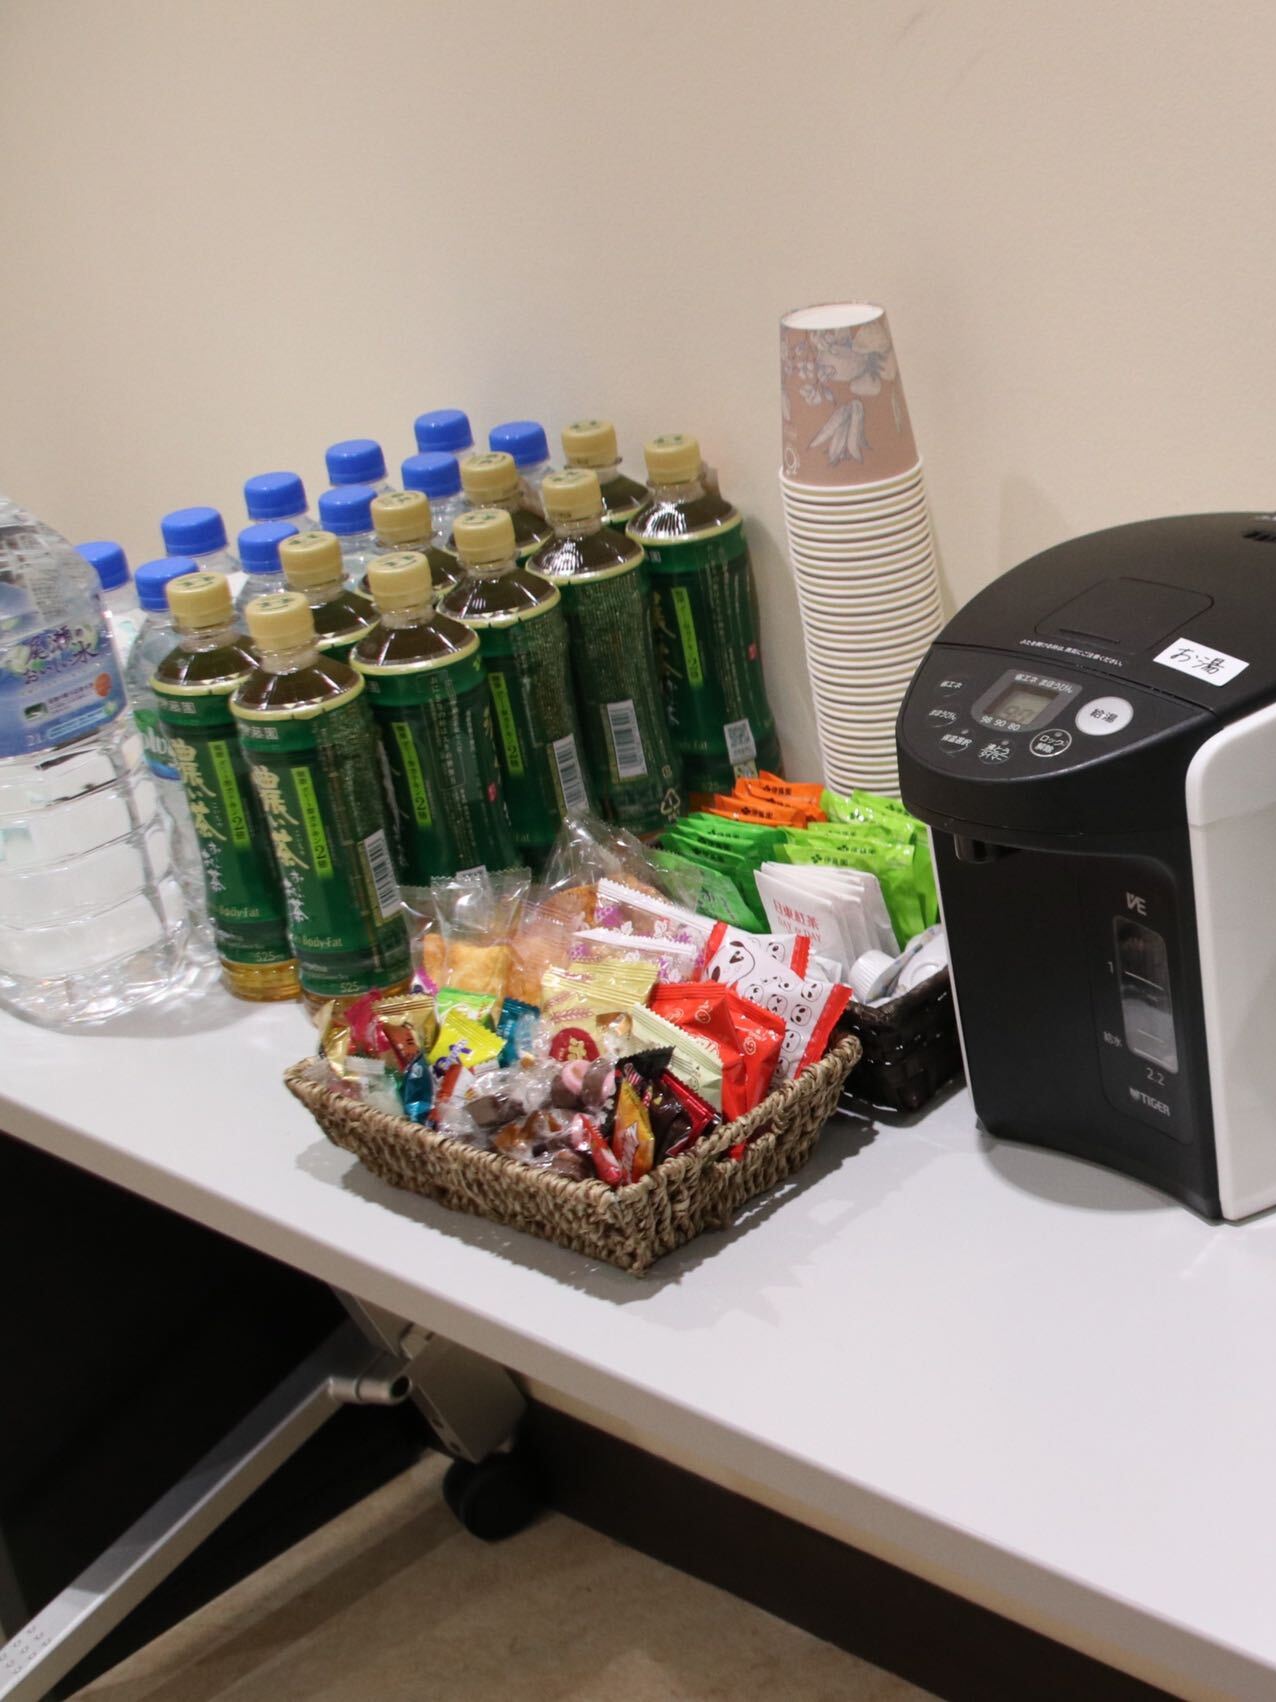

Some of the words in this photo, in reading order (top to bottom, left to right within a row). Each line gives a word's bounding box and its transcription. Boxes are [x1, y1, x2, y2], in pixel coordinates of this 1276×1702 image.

[1170, 647, 1226, 675] お湯
[1090, 708, 1119, 724] 給湯
[1146, 1066, 1166, 1087] 2.2
[1141, 1092, 1171, 1117] TIGER
